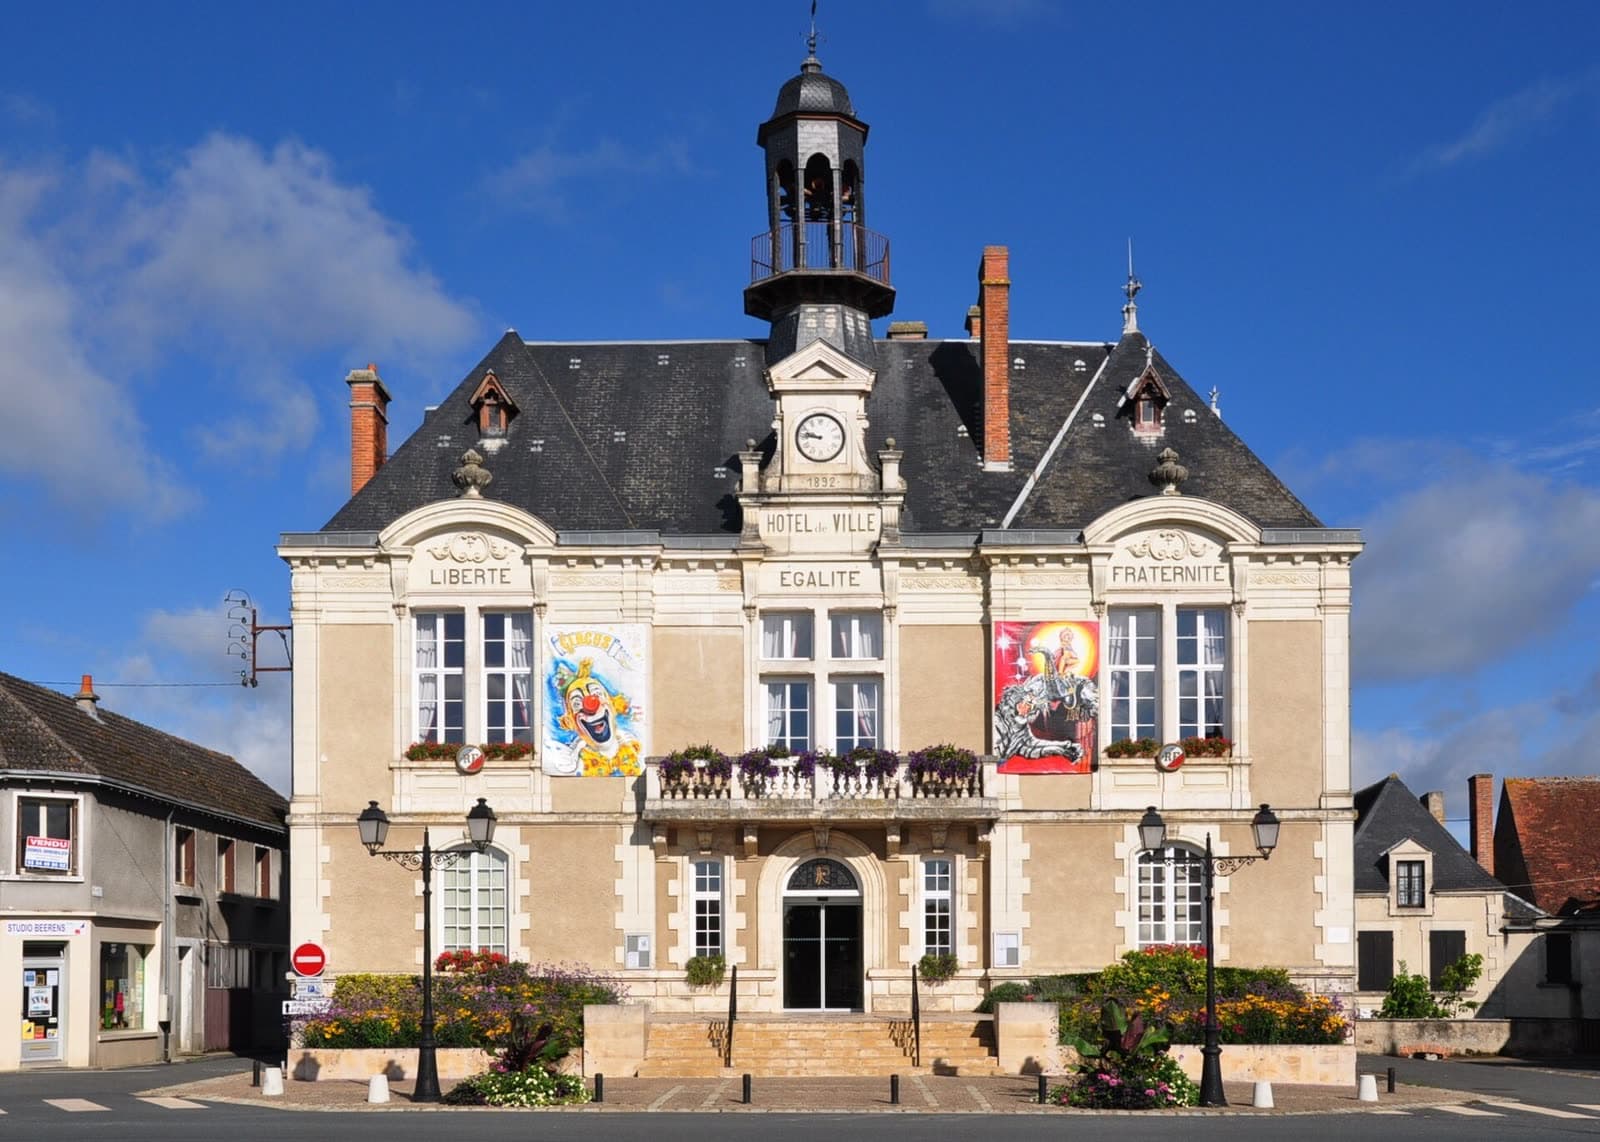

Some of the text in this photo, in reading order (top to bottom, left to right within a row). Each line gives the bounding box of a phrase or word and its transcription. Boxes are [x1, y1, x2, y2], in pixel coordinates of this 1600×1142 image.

[807, 476, 836, 488] 1892
[766, 513, 876, 533] HOTEL de VILLE
[430, 568, 512, 585] LIBERTE
[1112, 565, 1225, 583] FRATERNITE
[29, 838, 68, 849] VENDU
[7, 923, 66, 933] STUDIO BEERENS
